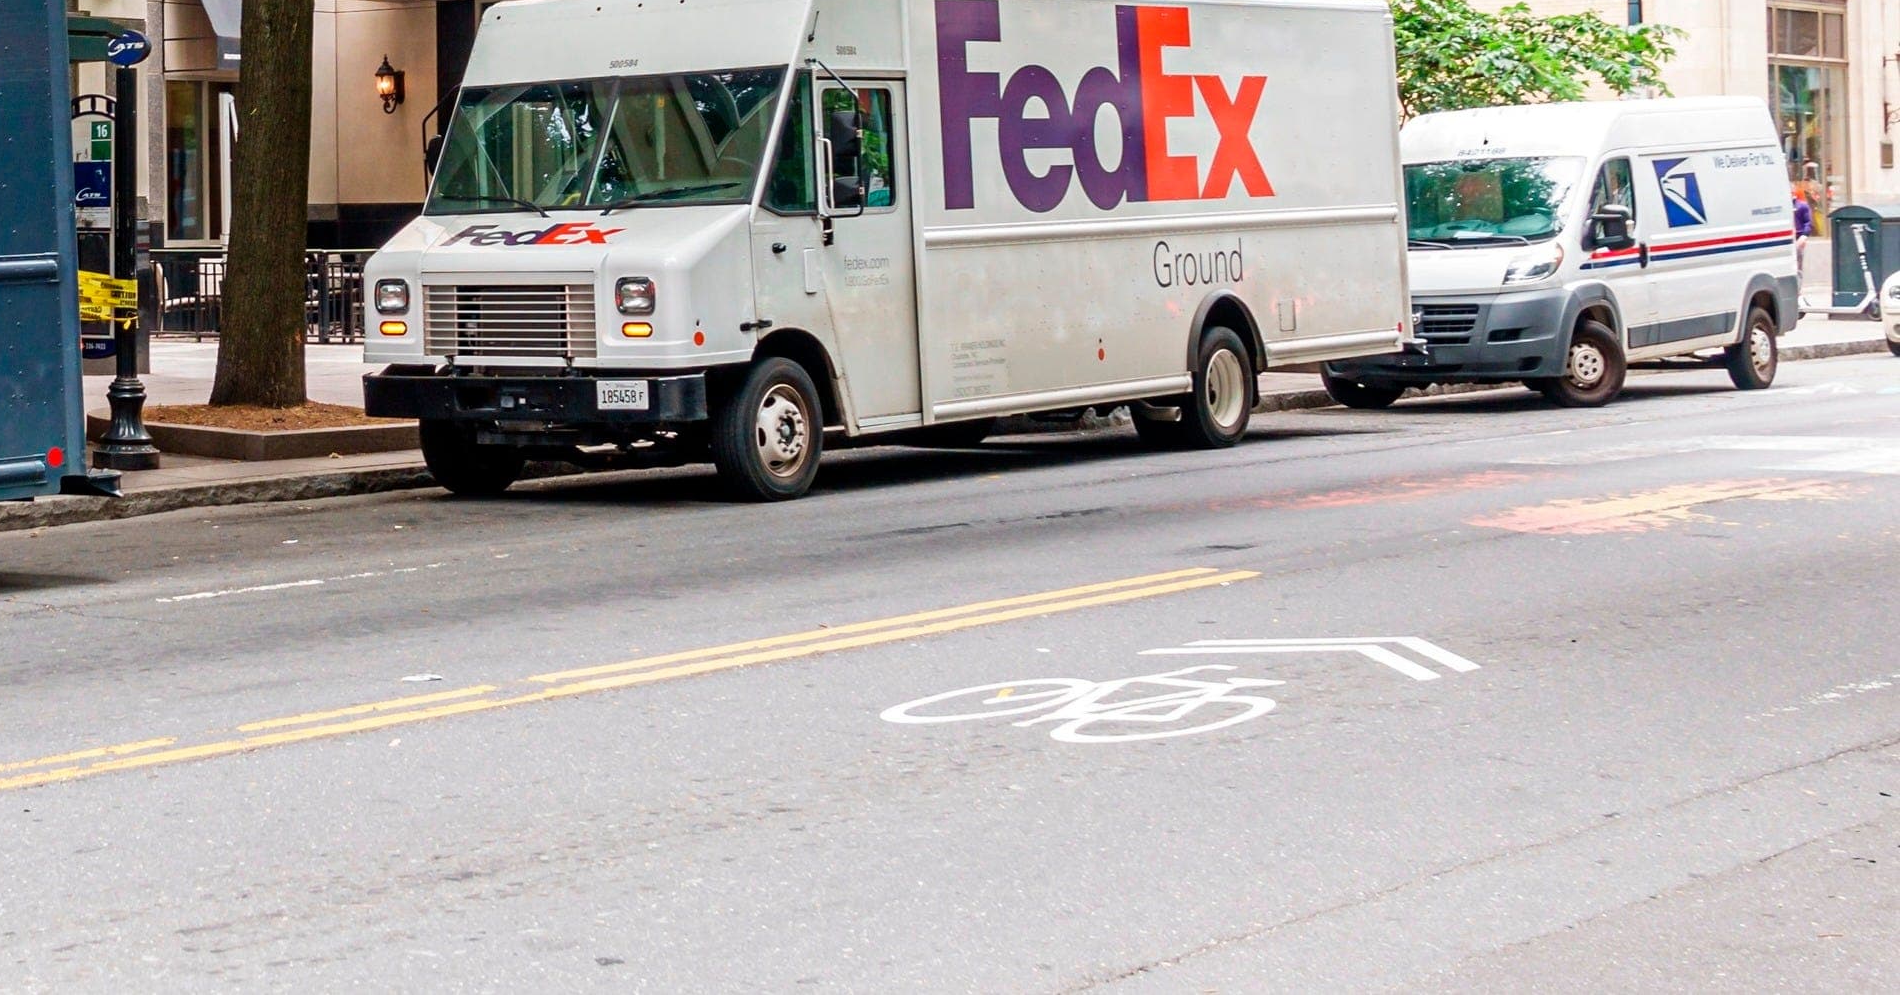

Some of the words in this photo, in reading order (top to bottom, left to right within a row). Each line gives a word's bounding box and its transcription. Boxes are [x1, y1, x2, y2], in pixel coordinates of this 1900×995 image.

[96, 124, 108, 138] 16
[439, 222, 627, 246] FedEx
[1153, 237, 1244, 288] Ground
[602, 389, 637, 404] 185458
